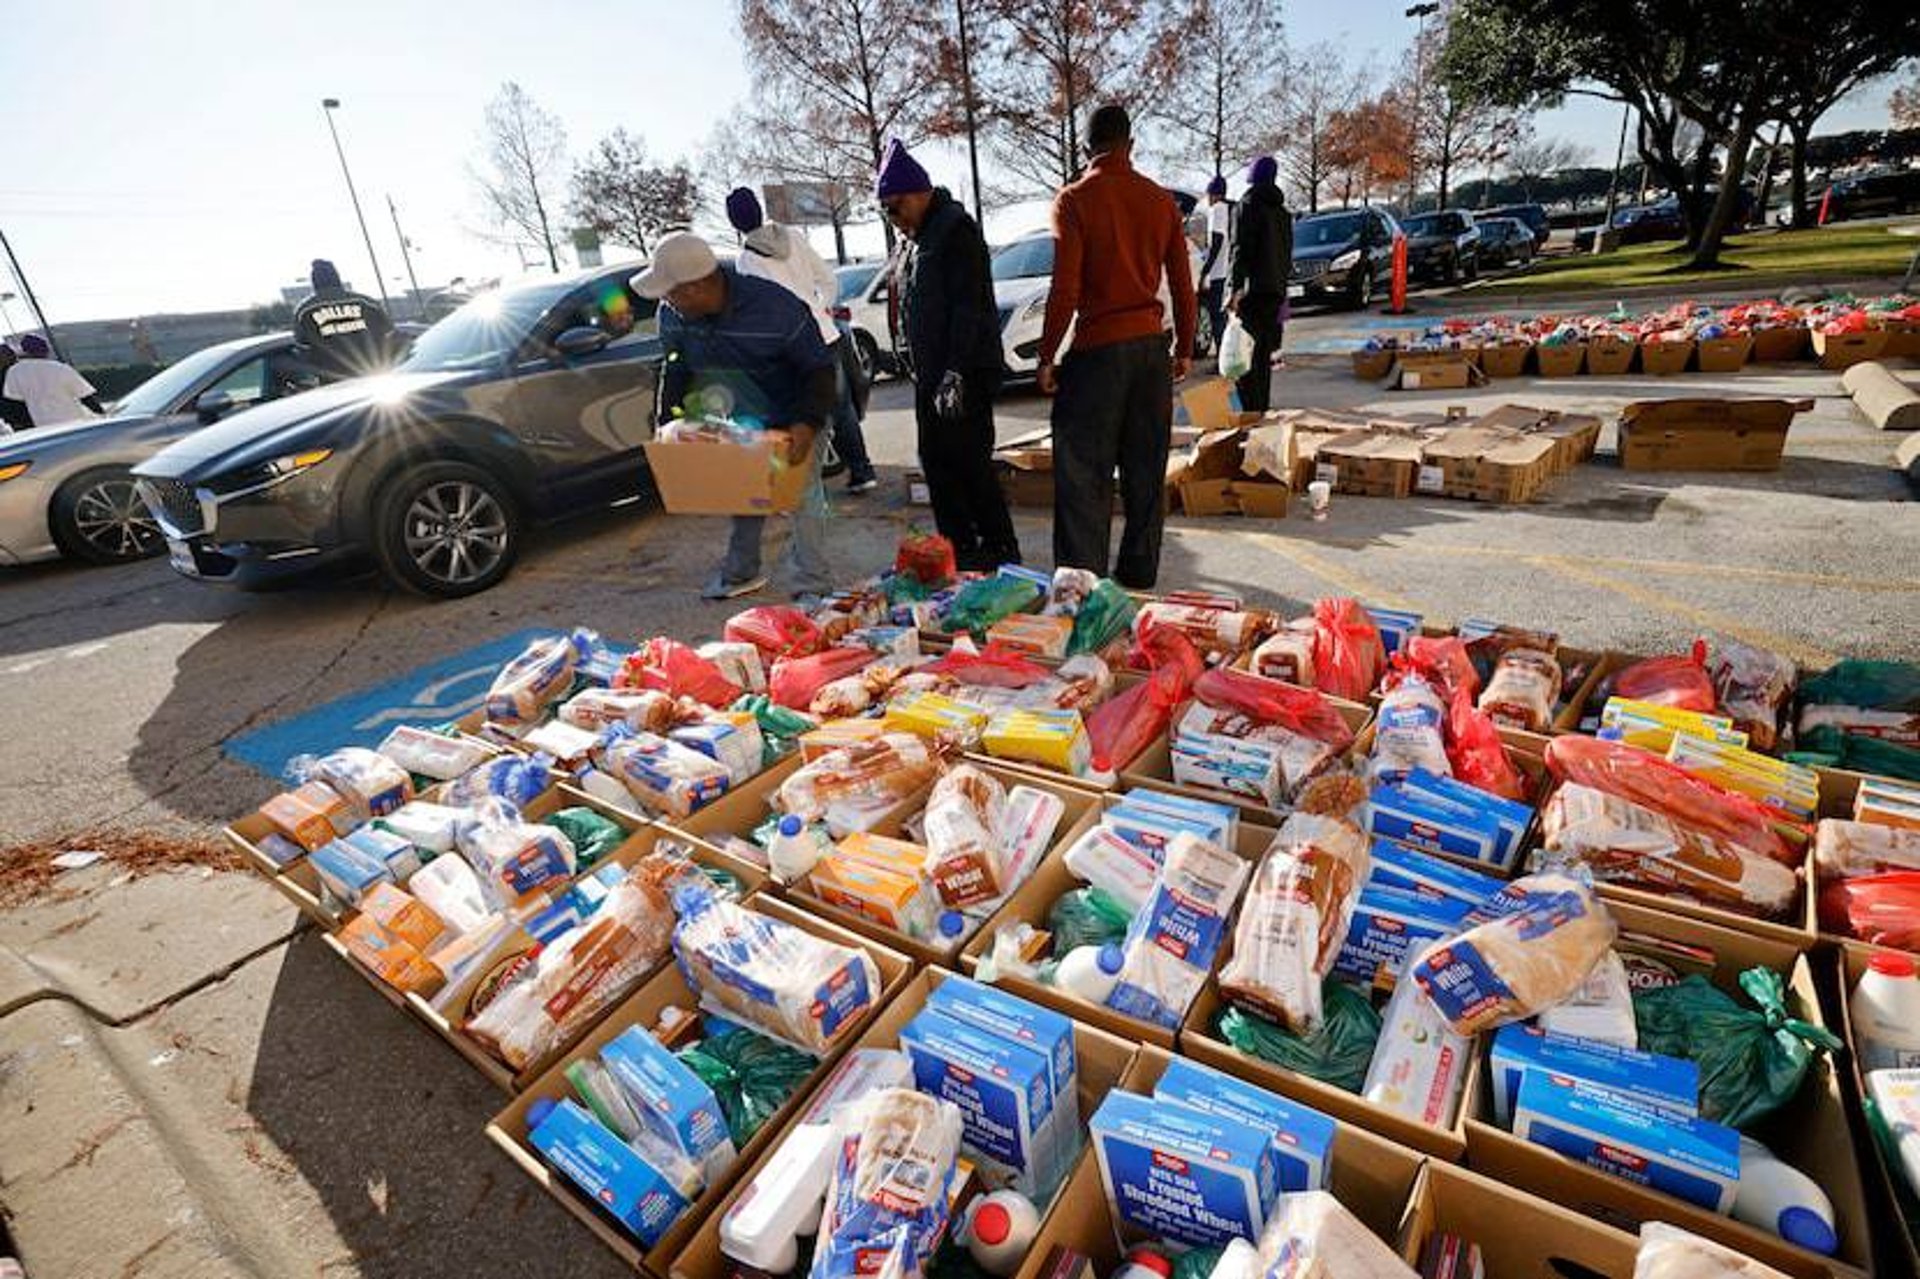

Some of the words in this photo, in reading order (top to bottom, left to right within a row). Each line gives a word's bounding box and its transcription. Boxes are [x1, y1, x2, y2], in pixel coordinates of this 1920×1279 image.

[311, 304, 362, 327] DALLAS
[1159, 914, 1201, 949] White
[1433, 961, 1475, 992] White
[1147, 1176, 1204, 1208] Frosted
[1121, 1183, 1191, 1219] Shredded
[1192, 1206, 1244, 1235] Wheat
